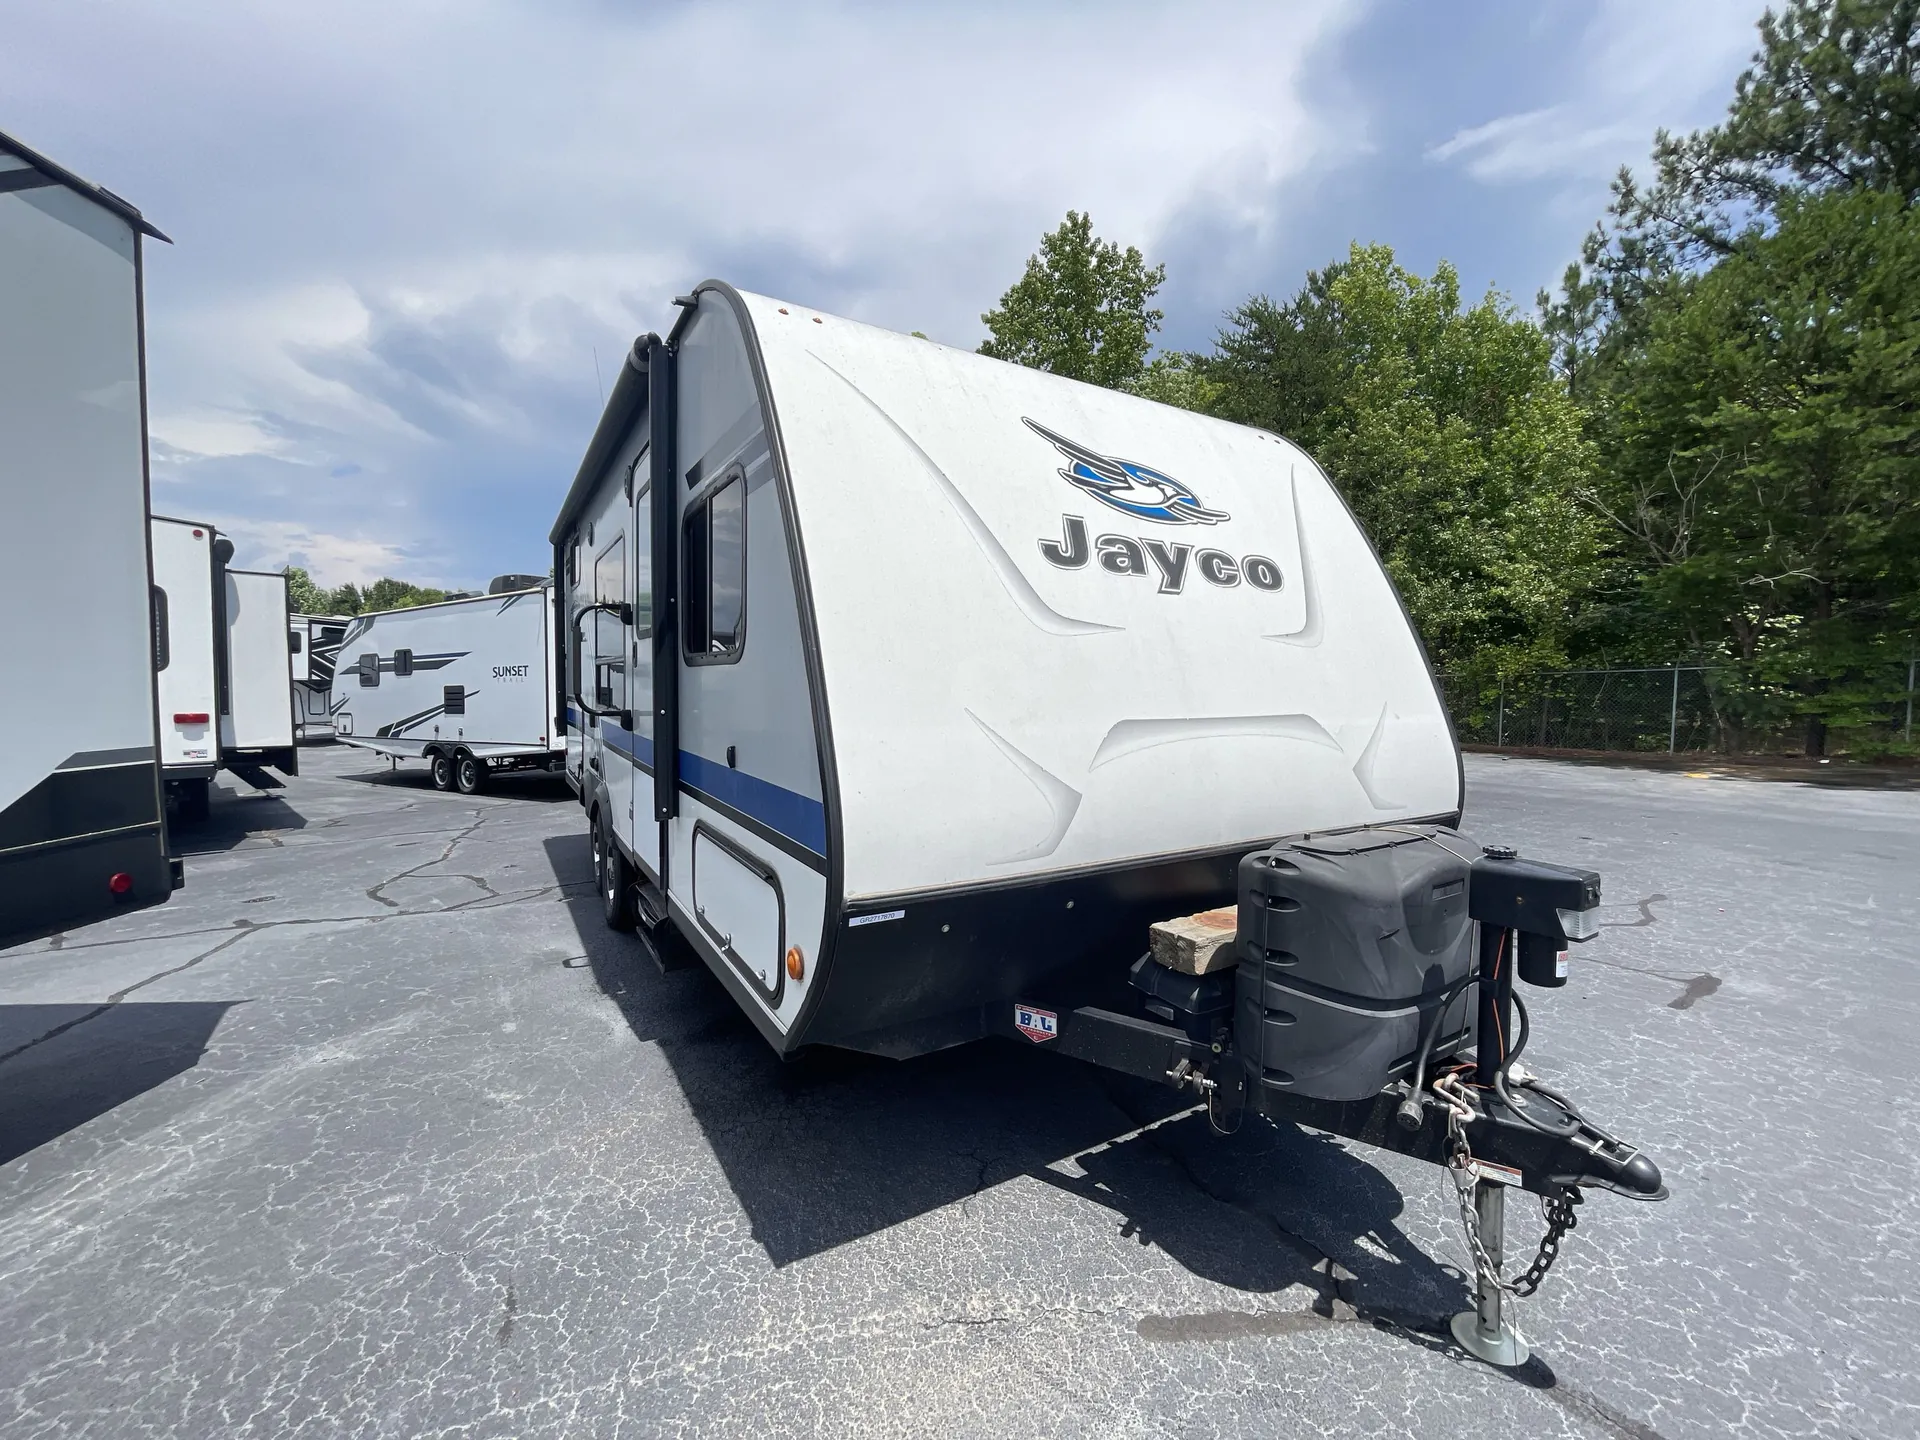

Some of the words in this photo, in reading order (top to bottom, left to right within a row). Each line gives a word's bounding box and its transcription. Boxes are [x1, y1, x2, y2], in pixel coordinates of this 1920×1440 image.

[1037, 513, 1285, 595] Jayco
[492, 664, 529, 678] SUNSET
[1019, 1011, 1053, 1032] BAL
